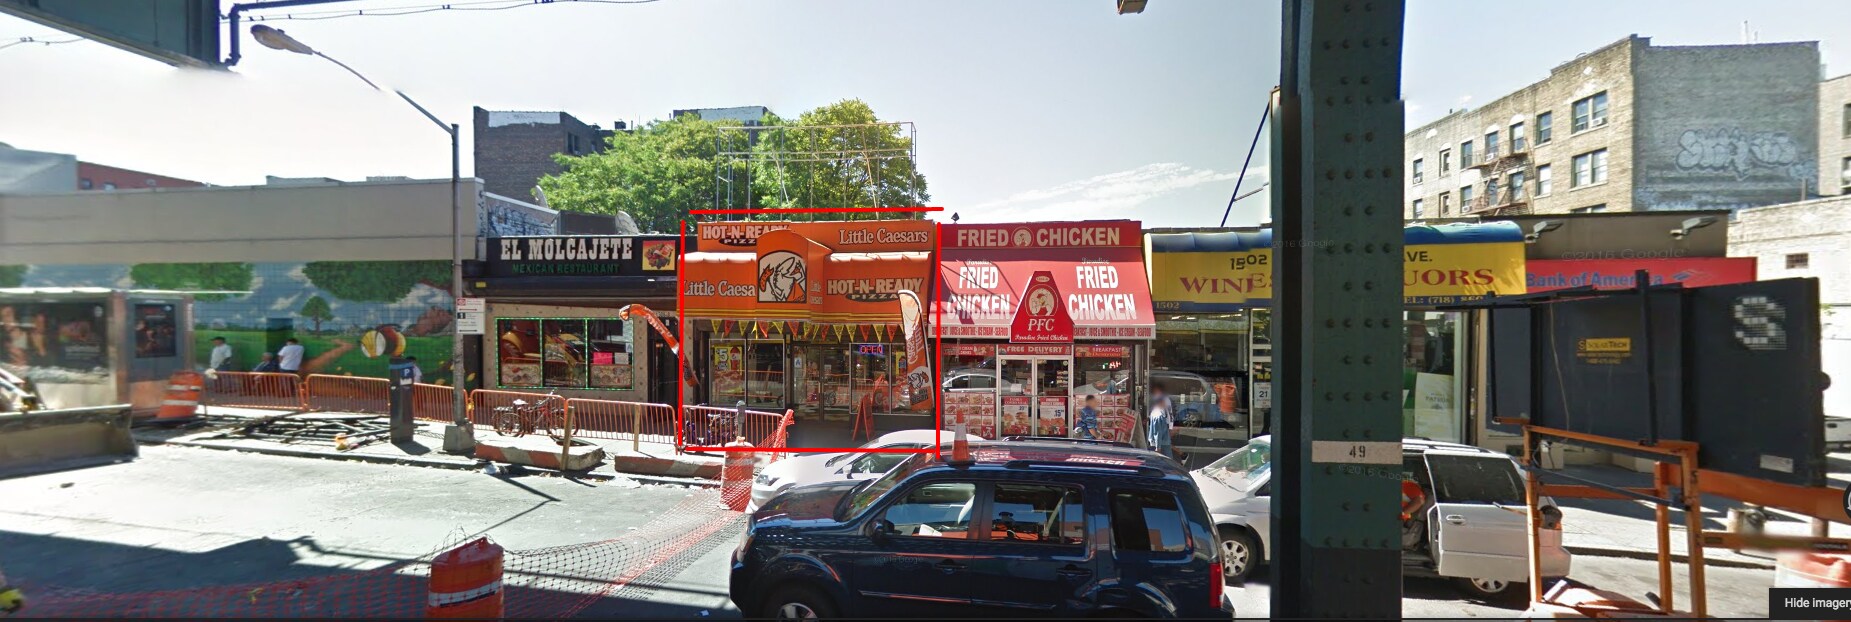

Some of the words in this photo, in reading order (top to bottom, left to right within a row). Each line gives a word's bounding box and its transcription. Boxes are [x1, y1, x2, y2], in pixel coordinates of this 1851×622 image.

[840, 228, 874, 245] Little
[876, 227, 928, 243] Caesars
[957, 229, 1009, 247] FRIED
[1036, 227, 1120, 246] CHICKEN
[500, 238, 522, 260] EL
[528, 237, 633, 260] MOLCAJETE
[1403, 250, 1433, 262] VE.
[512, 263, 555, 273] MEXICAN
[558, 262, 619, 273] RESTAURANT
[1230, 254, 1268, 270] 1502
[959, 266, 999, 289] FRIED
[1076, 265, 1119, 289] FRIED
[1179, 273, 1272, 295] WINE
[1526, 271, 1566, 287] Bank
[1569, 271, 1588, 287] of
[1591, 271, 1664, 286] Amera
[684, 280, 715, 296] Little
[827, 279, 923, 295] HOT-N-READY
[946, 294, 1010, 320] CHICKEN
[1068, 293, 1137, 320] CHICKEN
[1027, 318, 1055, 331] PFC
[860, 345, 883, 354] OPEN
[1349, 445, 1366, 458] 49
